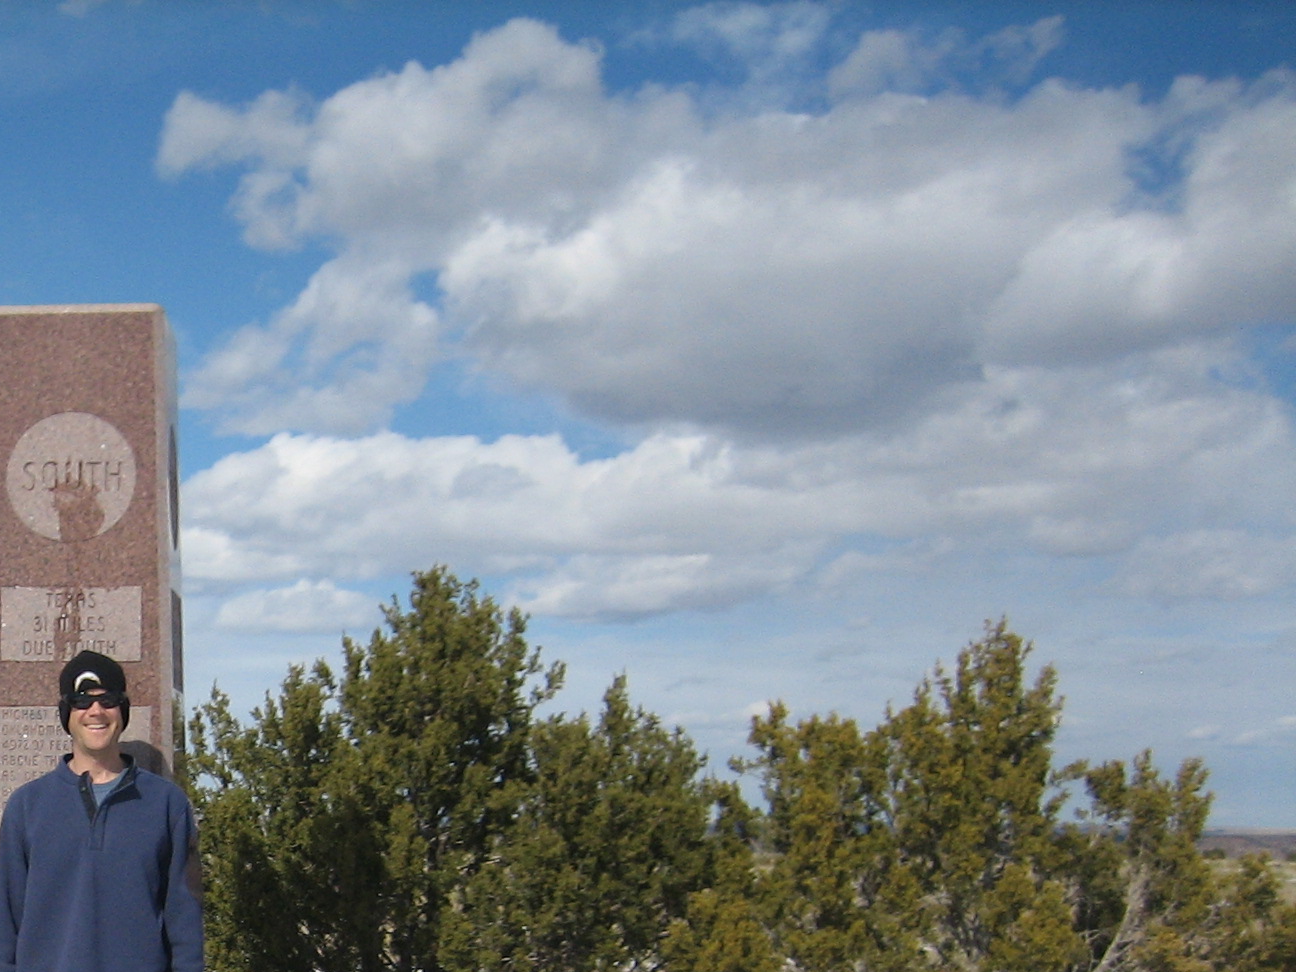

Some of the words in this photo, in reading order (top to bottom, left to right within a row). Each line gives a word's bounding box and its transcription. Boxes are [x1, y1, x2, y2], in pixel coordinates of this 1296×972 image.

[22, 460, 121, 491] SOUTH
[46, 592, 95, 608] TEXAS
[33, 616, 48, 632] 31
[58, 616, 105, 632] MILES
[23, 640, 53, 655] DUE
[2, 709, 47, 720] HIGHEST
[2, 754, 38, 766] ABOVE
[2, 770, 15, 781] AS
